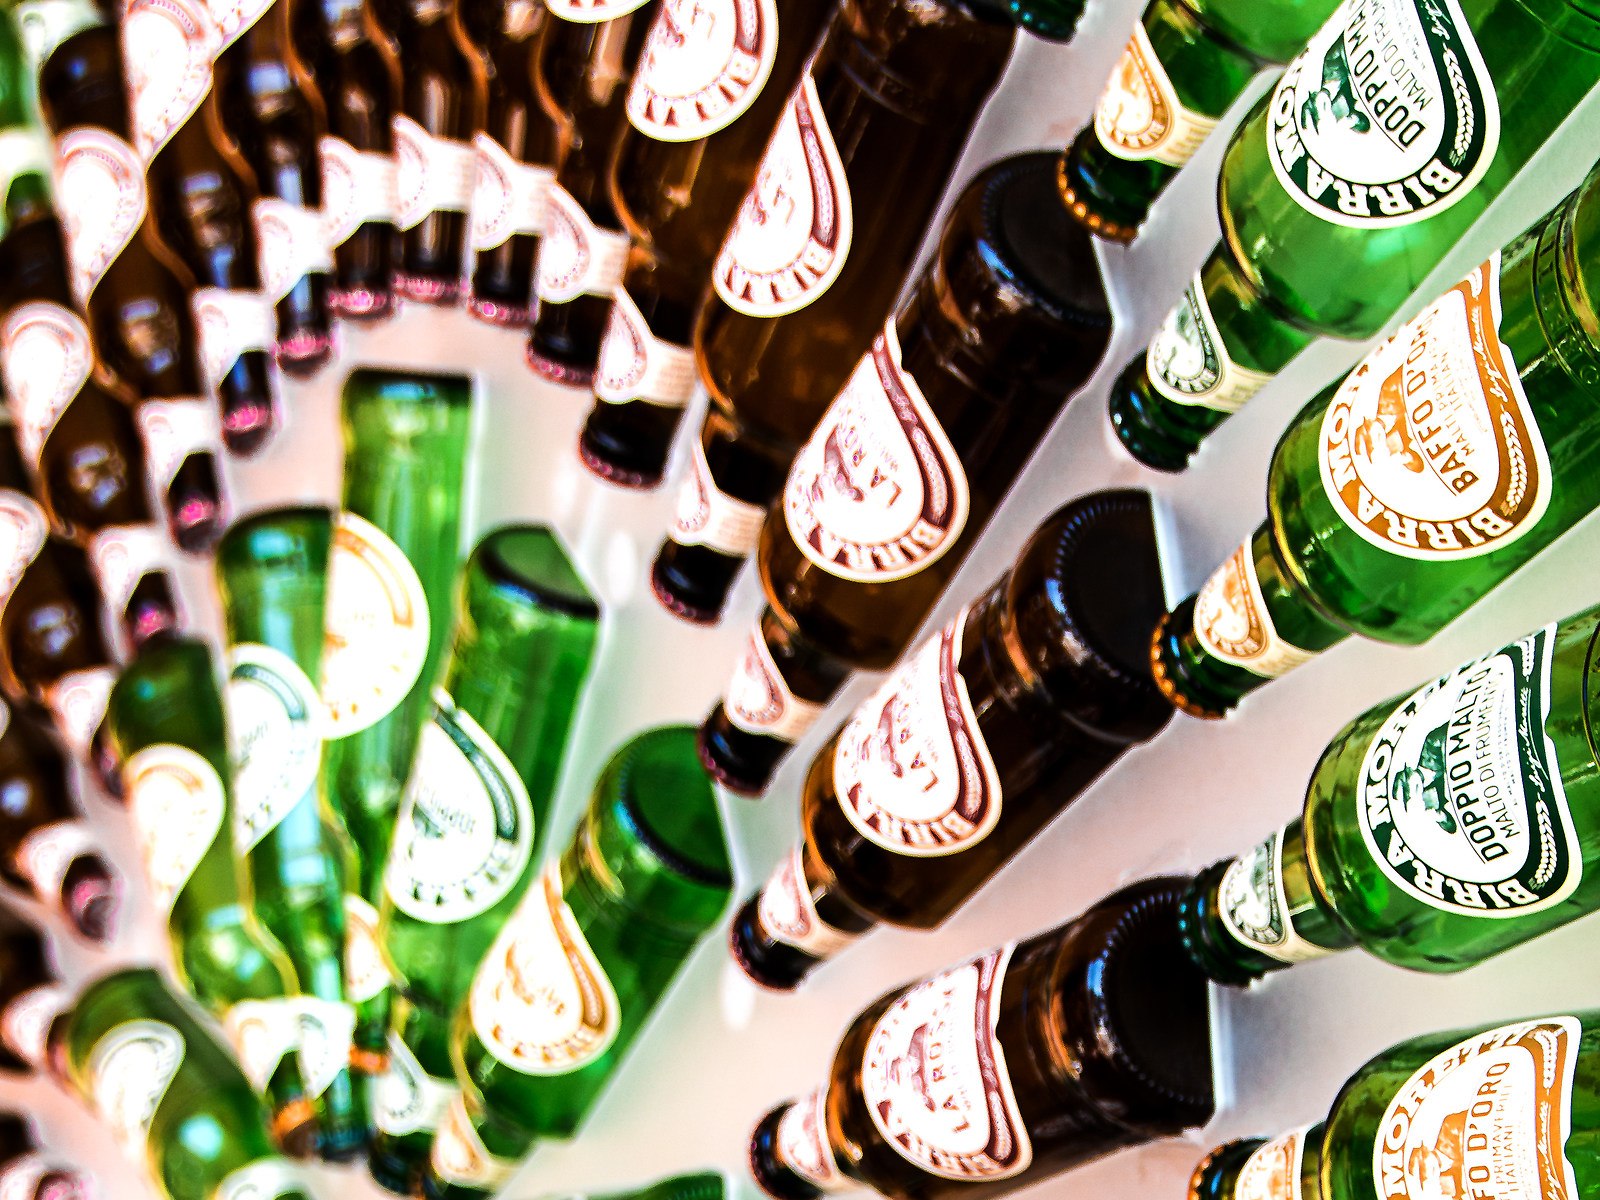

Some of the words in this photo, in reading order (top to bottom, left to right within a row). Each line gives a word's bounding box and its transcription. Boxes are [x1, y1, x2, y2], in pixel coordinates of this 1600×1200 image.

[1354, 49, 1426, 148] DOPPIO
[1390, 58, 1434, 111] MALTO
[1306, 157, 1464, 217] BIRRA
[1412, 399, 1479, 495] BAFFO
[818, 518, 947, 570] BIRRA
[1357, 484, 1514, 551] BIRRA
[1449, 667, 1492, 757] MALTO
[1479, 761, 1495, 783] DI
[1450, 760, 1510, 863] DOPPIO
[1483, 785, 1521, 839] MALTO
[1387, 829, 1540, 910] BIRRA
[1466, 1062, 1511, 1152] D'ORO
[1501, 1125, 1520, 1192] ITALIANI
